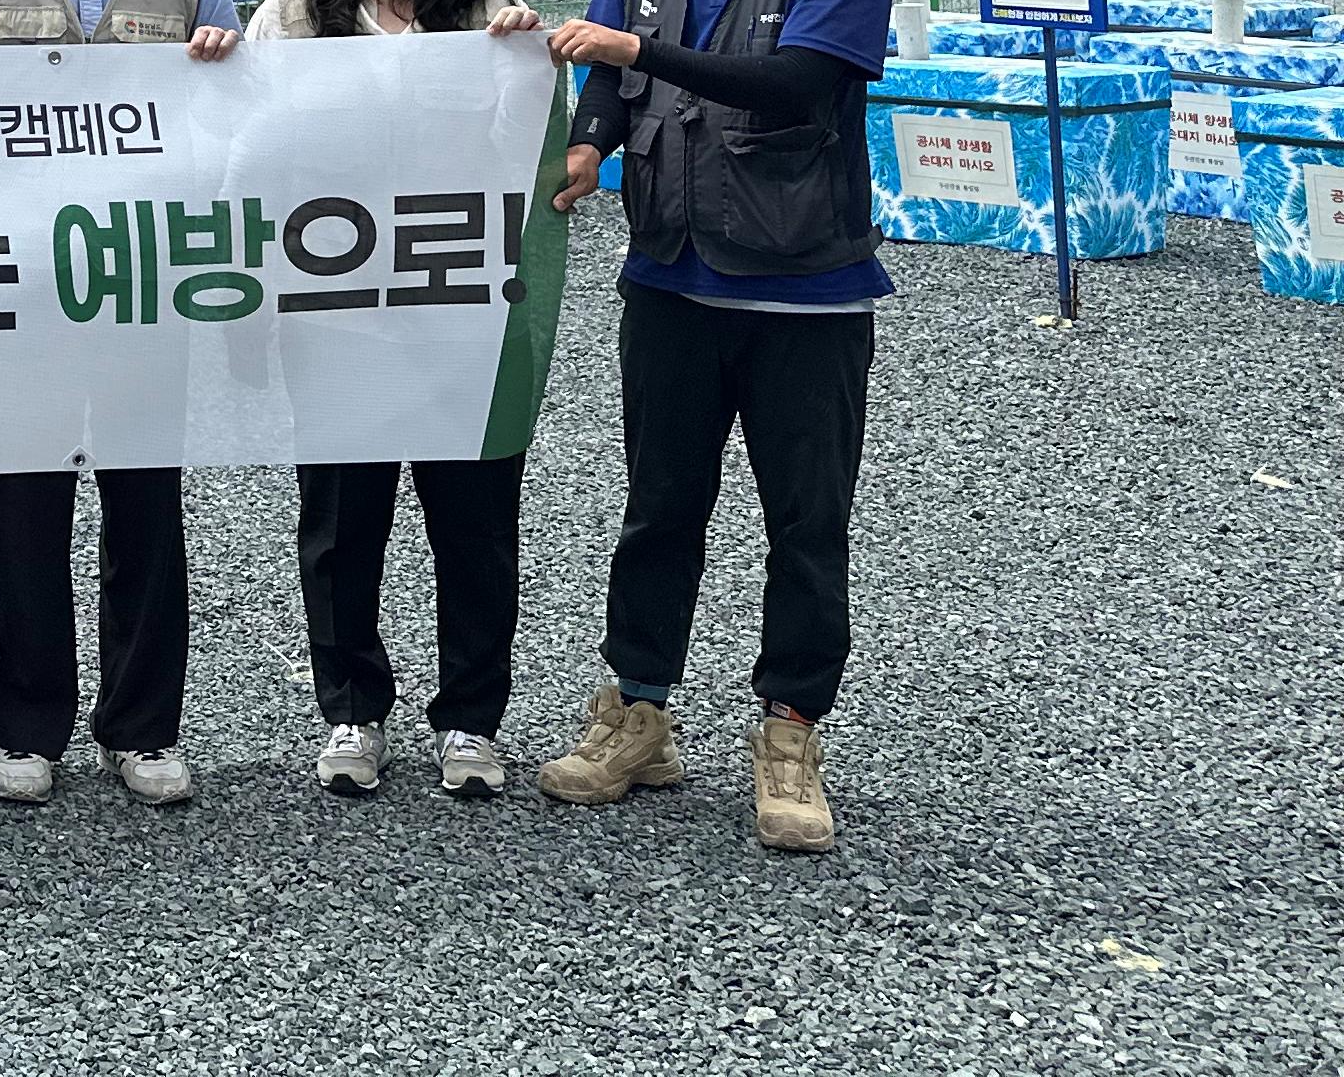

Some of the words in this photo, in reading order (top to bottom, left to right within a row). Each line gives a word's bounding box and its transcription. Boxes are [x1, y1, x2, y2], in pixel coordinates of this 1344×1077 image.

[0, 100, 165, 159] 캠페인
[915, 135, 952, 150] 공시체
[918, 154, 954, 169] 손대지
[959, 158, 996, 173] 마시오
[52, 190, 528, 327] 예방으로!
